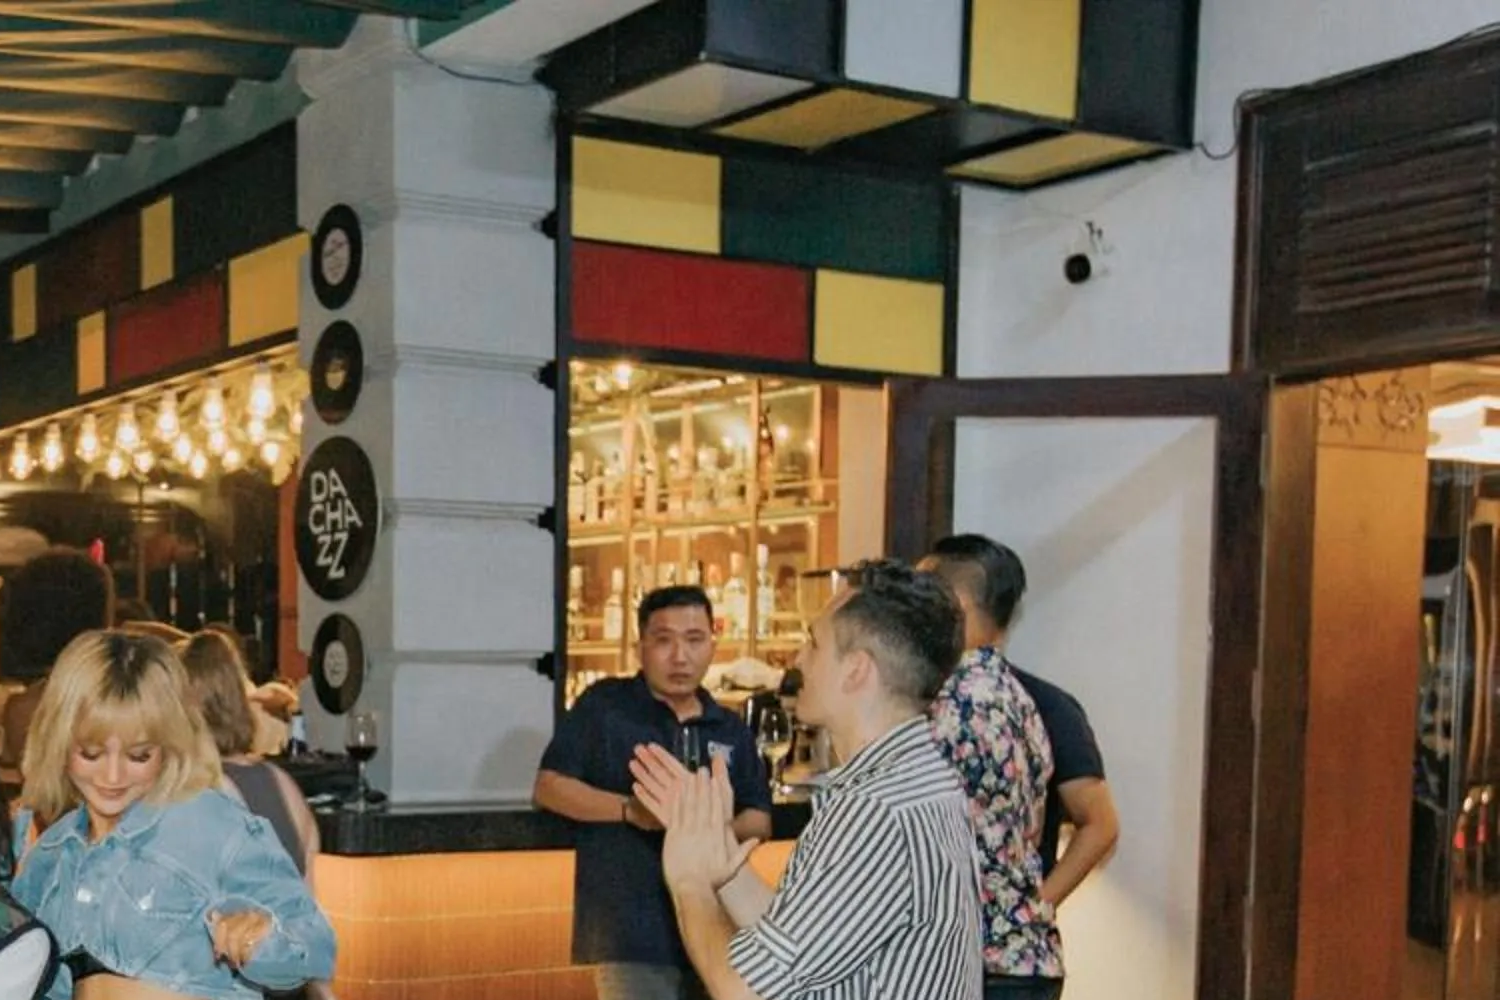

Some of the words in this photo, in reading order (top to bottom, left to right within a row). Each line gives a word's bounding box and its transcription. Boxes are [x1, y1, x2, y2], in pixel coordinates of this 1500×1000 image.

[310, 468, 348, 503] DA
[308, 498, 363, 535] CHA
[316, 532, 348, 579] ZZ
